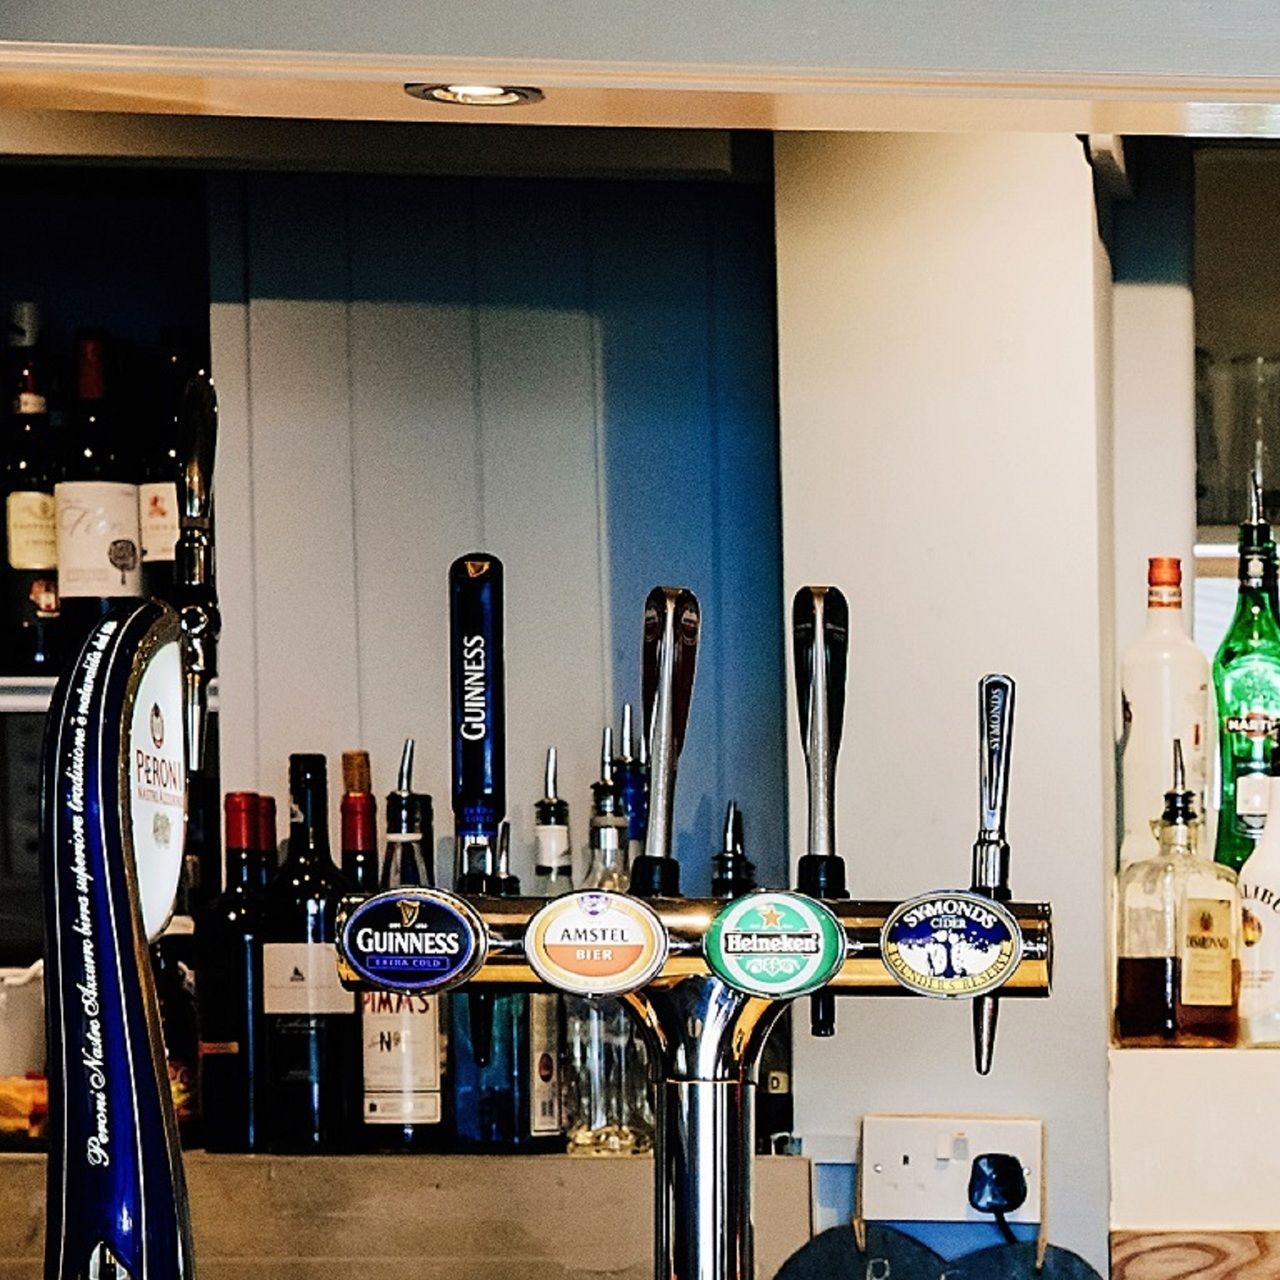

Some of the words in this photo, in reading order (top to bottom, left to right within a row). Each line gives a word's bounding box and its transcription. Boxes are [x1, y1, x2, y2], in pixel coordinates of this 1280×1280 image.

[460, 634, 487, 740] GUINNESS
[989, 687, 1002, 751] SYMONDS
[136, 749, 182, 791] PERONI
[68, 812, 93, 882] superiore
[72, 893, 93, 935] birra
[902, 899, 997, 929] SYMONDS
[930, 917, 967, 929] CIDER
[356, 927, 459, 954] GUINNESS
[560, 927, 630, 942] AMSTEL
[727, 934, 818, 952] Heineken
[413, 958, 441, 967] COLD
[575, 949, 613, 961] BIER
[82, 1020, 105, 1089] Nastro
[87, 1088, 109, 1167] Peroni
